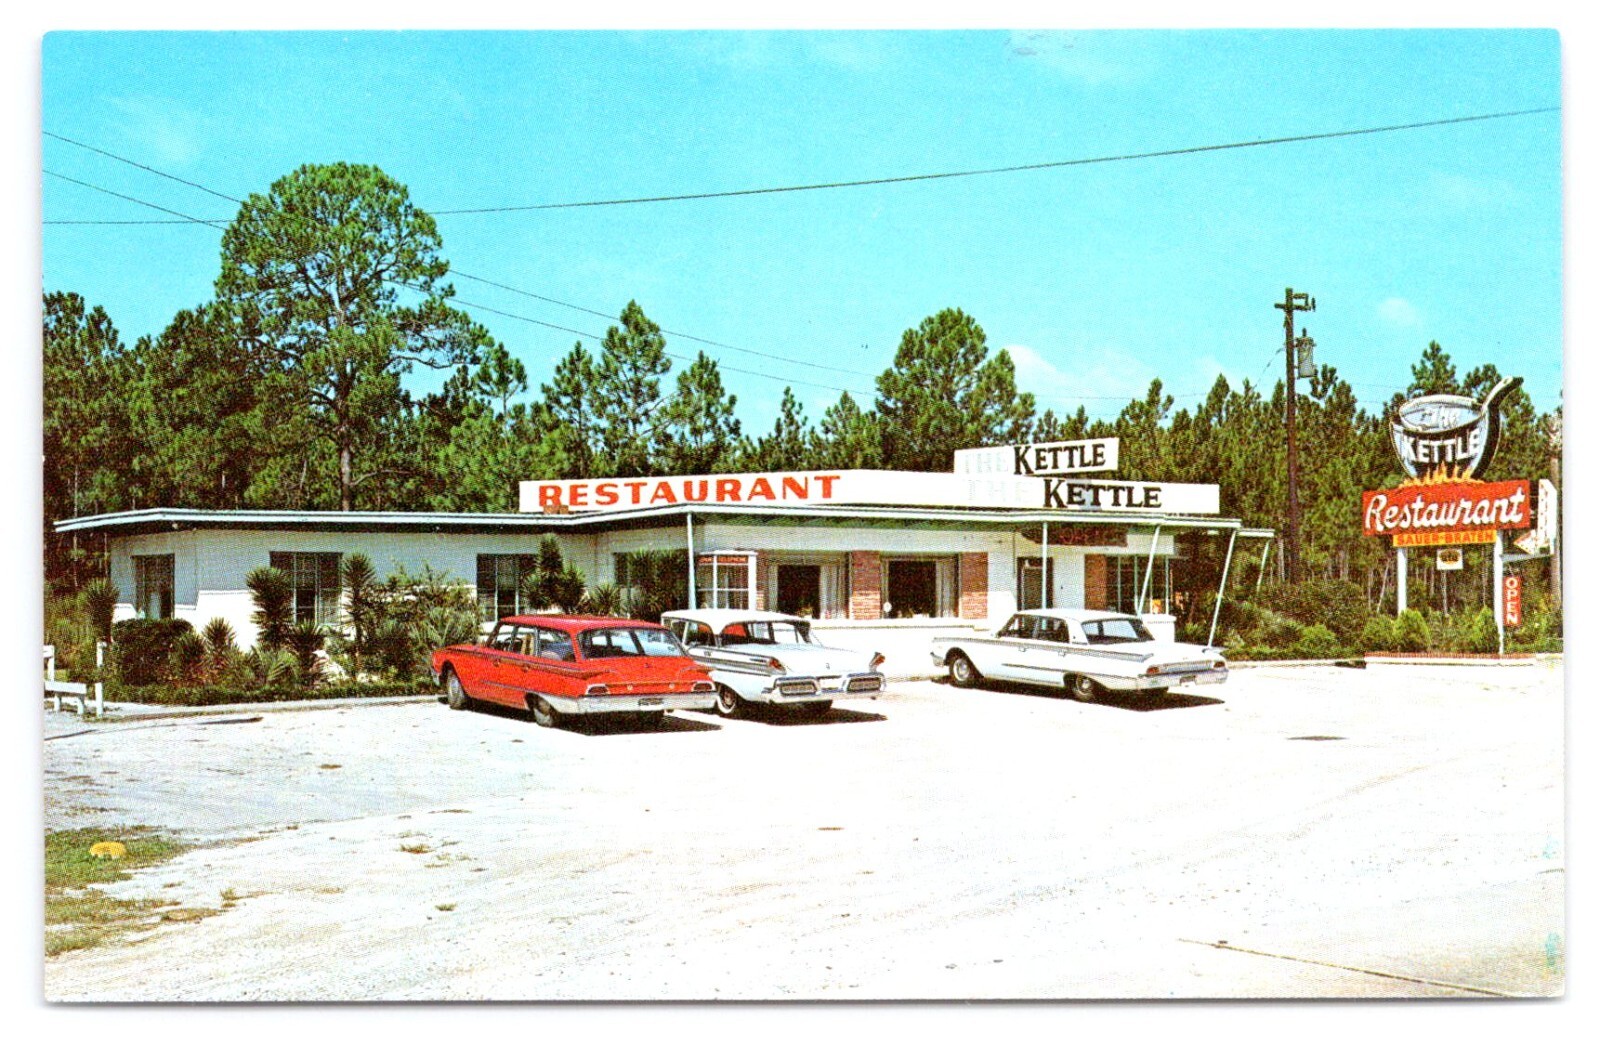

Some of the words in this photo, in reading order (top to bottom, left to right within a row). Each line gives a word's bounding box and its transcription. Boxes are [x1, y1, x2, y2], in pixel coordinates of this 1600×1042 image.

[1013, 443, 1106, 475] KETTLE
[1401, 428, 1480, 463] KETTLE
[538, 475, 841, 507] RESTAURANT
[1043, 478, 1163, 508] KETTLE
[1365, 487, 1525, 531] Restaurant
[1505, 577, 1518, 624] OPEN
